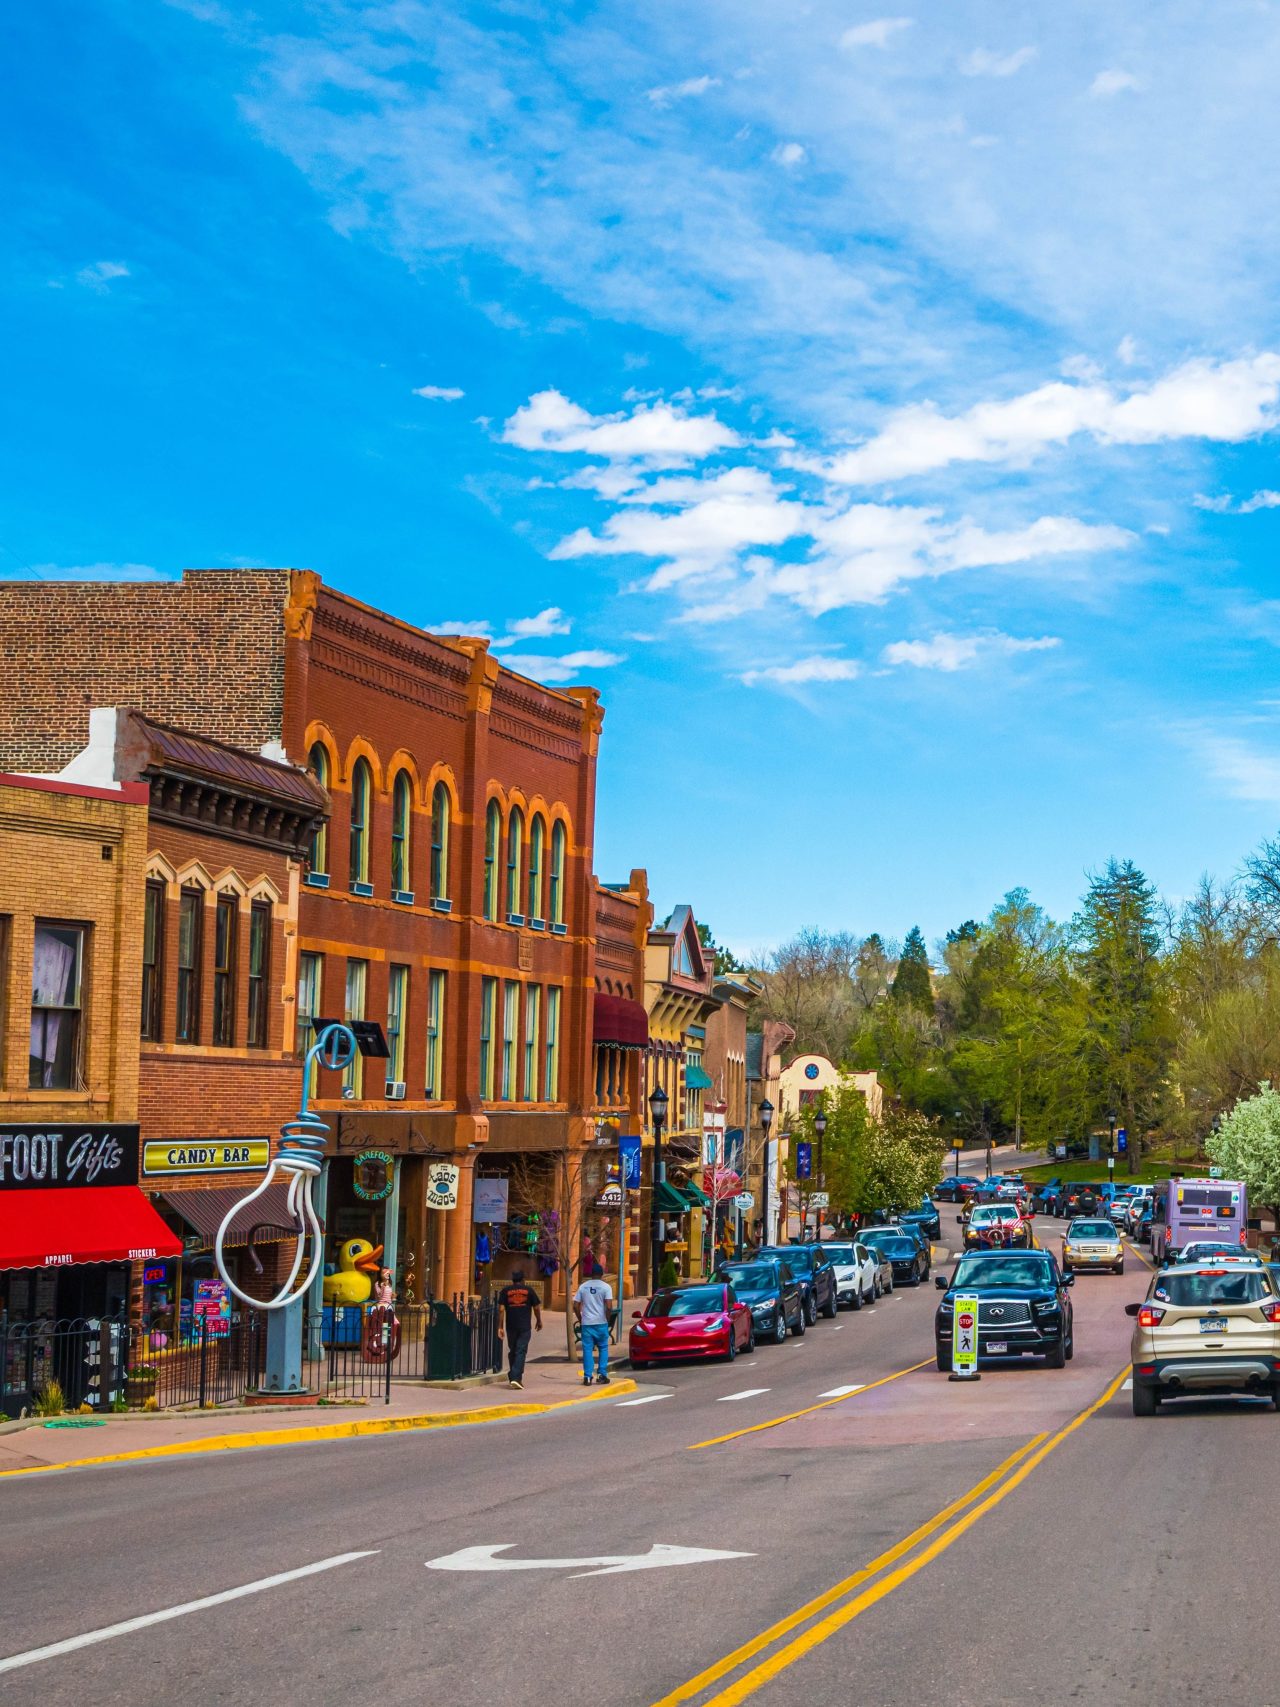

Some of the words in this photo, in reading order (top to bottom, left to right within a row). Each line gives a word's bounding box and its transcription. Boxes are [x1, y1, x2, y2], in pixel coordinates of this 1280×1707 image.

[0, 1133, 63, 1181] FOOT
[66, 1132, 124, 1183] Gifts
[167, 1148, 217, 1165] CANDY
[223, 1147, 250, 1163] BAR
[353, 1150, 394, 1166] BAREFOOT
[353, 1183, 371, 1200] NATIVE
[45, 1254, 73, 1265] APPAREL
[128, 1248, 157, 1259] STICKERS
[146, 1268, 164, 1280] OPEN
